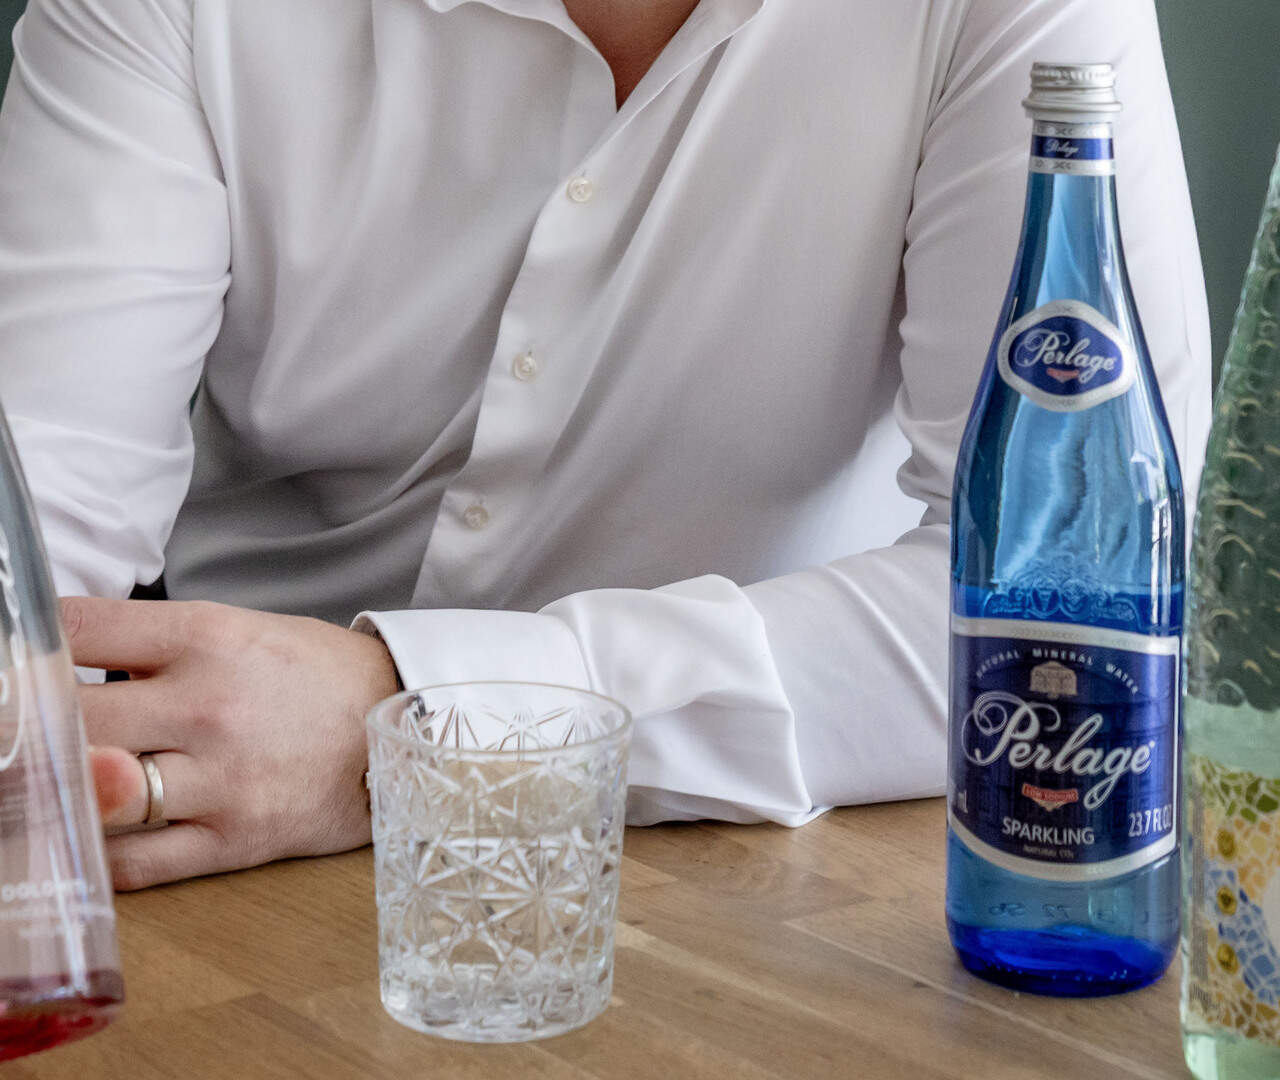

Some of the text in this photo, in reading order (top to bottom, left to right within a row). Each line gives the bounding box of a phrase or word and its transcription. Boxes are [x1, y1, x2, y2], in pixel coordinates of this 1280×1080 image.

[1015, 328, 1116, 384] Perlage
[976, 647, 1139, 695] NATURAL MINERAL WATER
[961, 691, 1152, 811] Perlage
[1002, 816, 1095, 846] SPARKLING
